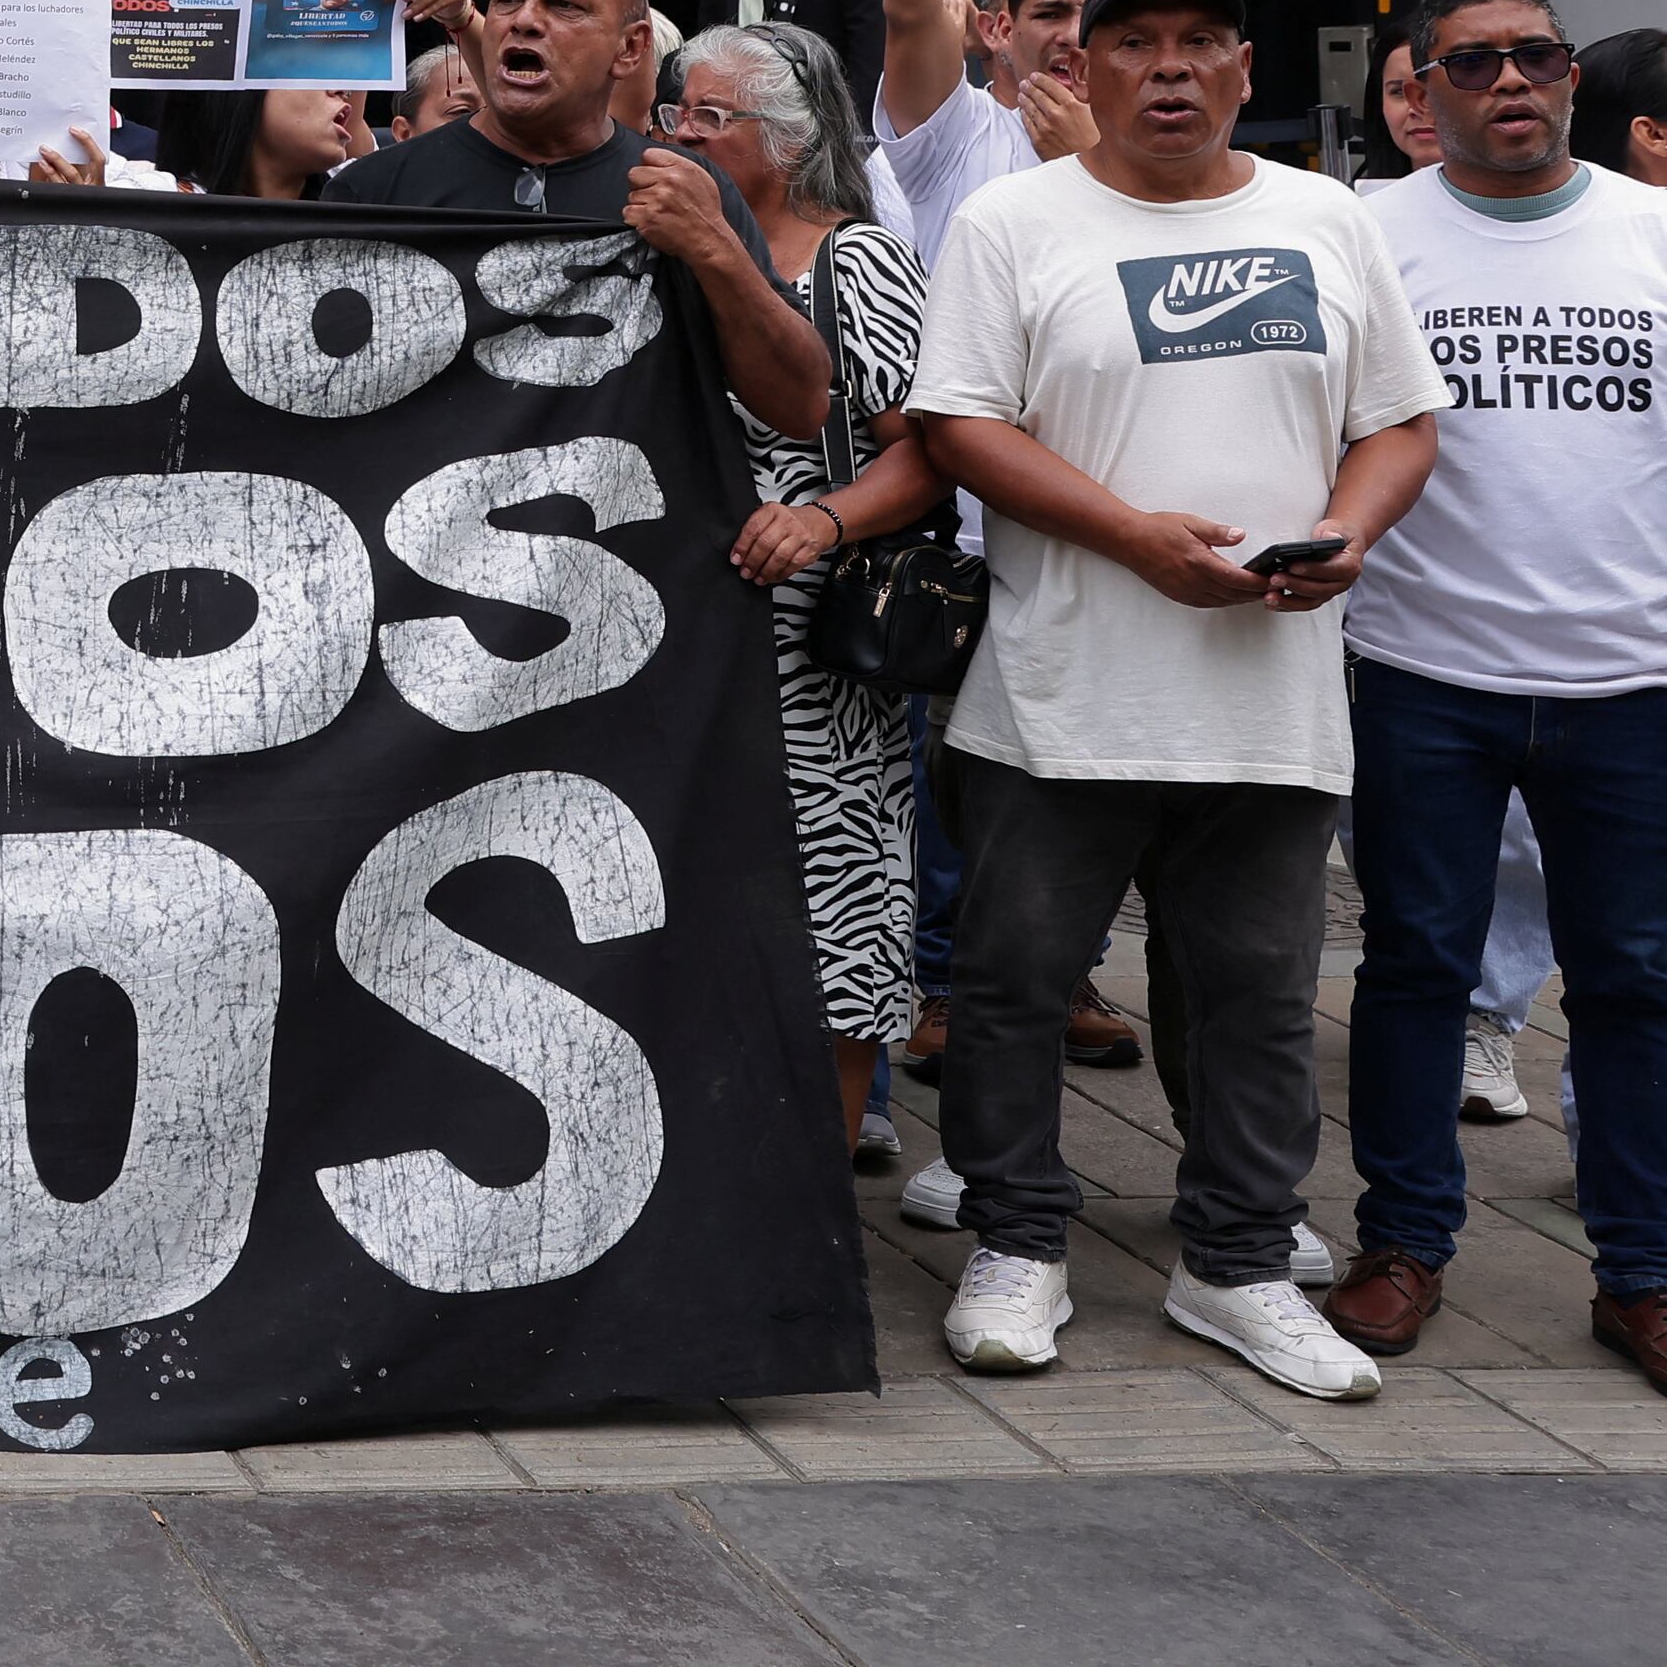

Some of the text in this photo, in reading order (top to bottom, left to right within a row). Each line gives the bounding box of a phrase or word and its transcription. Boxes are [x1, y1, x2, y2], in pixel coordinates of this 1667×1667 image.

[1, 4, 21, 14] para
[23, 3, 36, 12] los
[38, 4, 84, 14] luchadores
[6, 35, 35, 46] Cortés
[1167, 256, 1276, 298] NIKE
[1532, 306, 1551, 327] A
[1560, 306, 1653, 332] TODOS
[1160, 324, 1299, 355] OREGON 1972
[1431, 333, 1653, 369] OS PRESOS
[1447, 365, 1653, 413] OLÍTICOS
